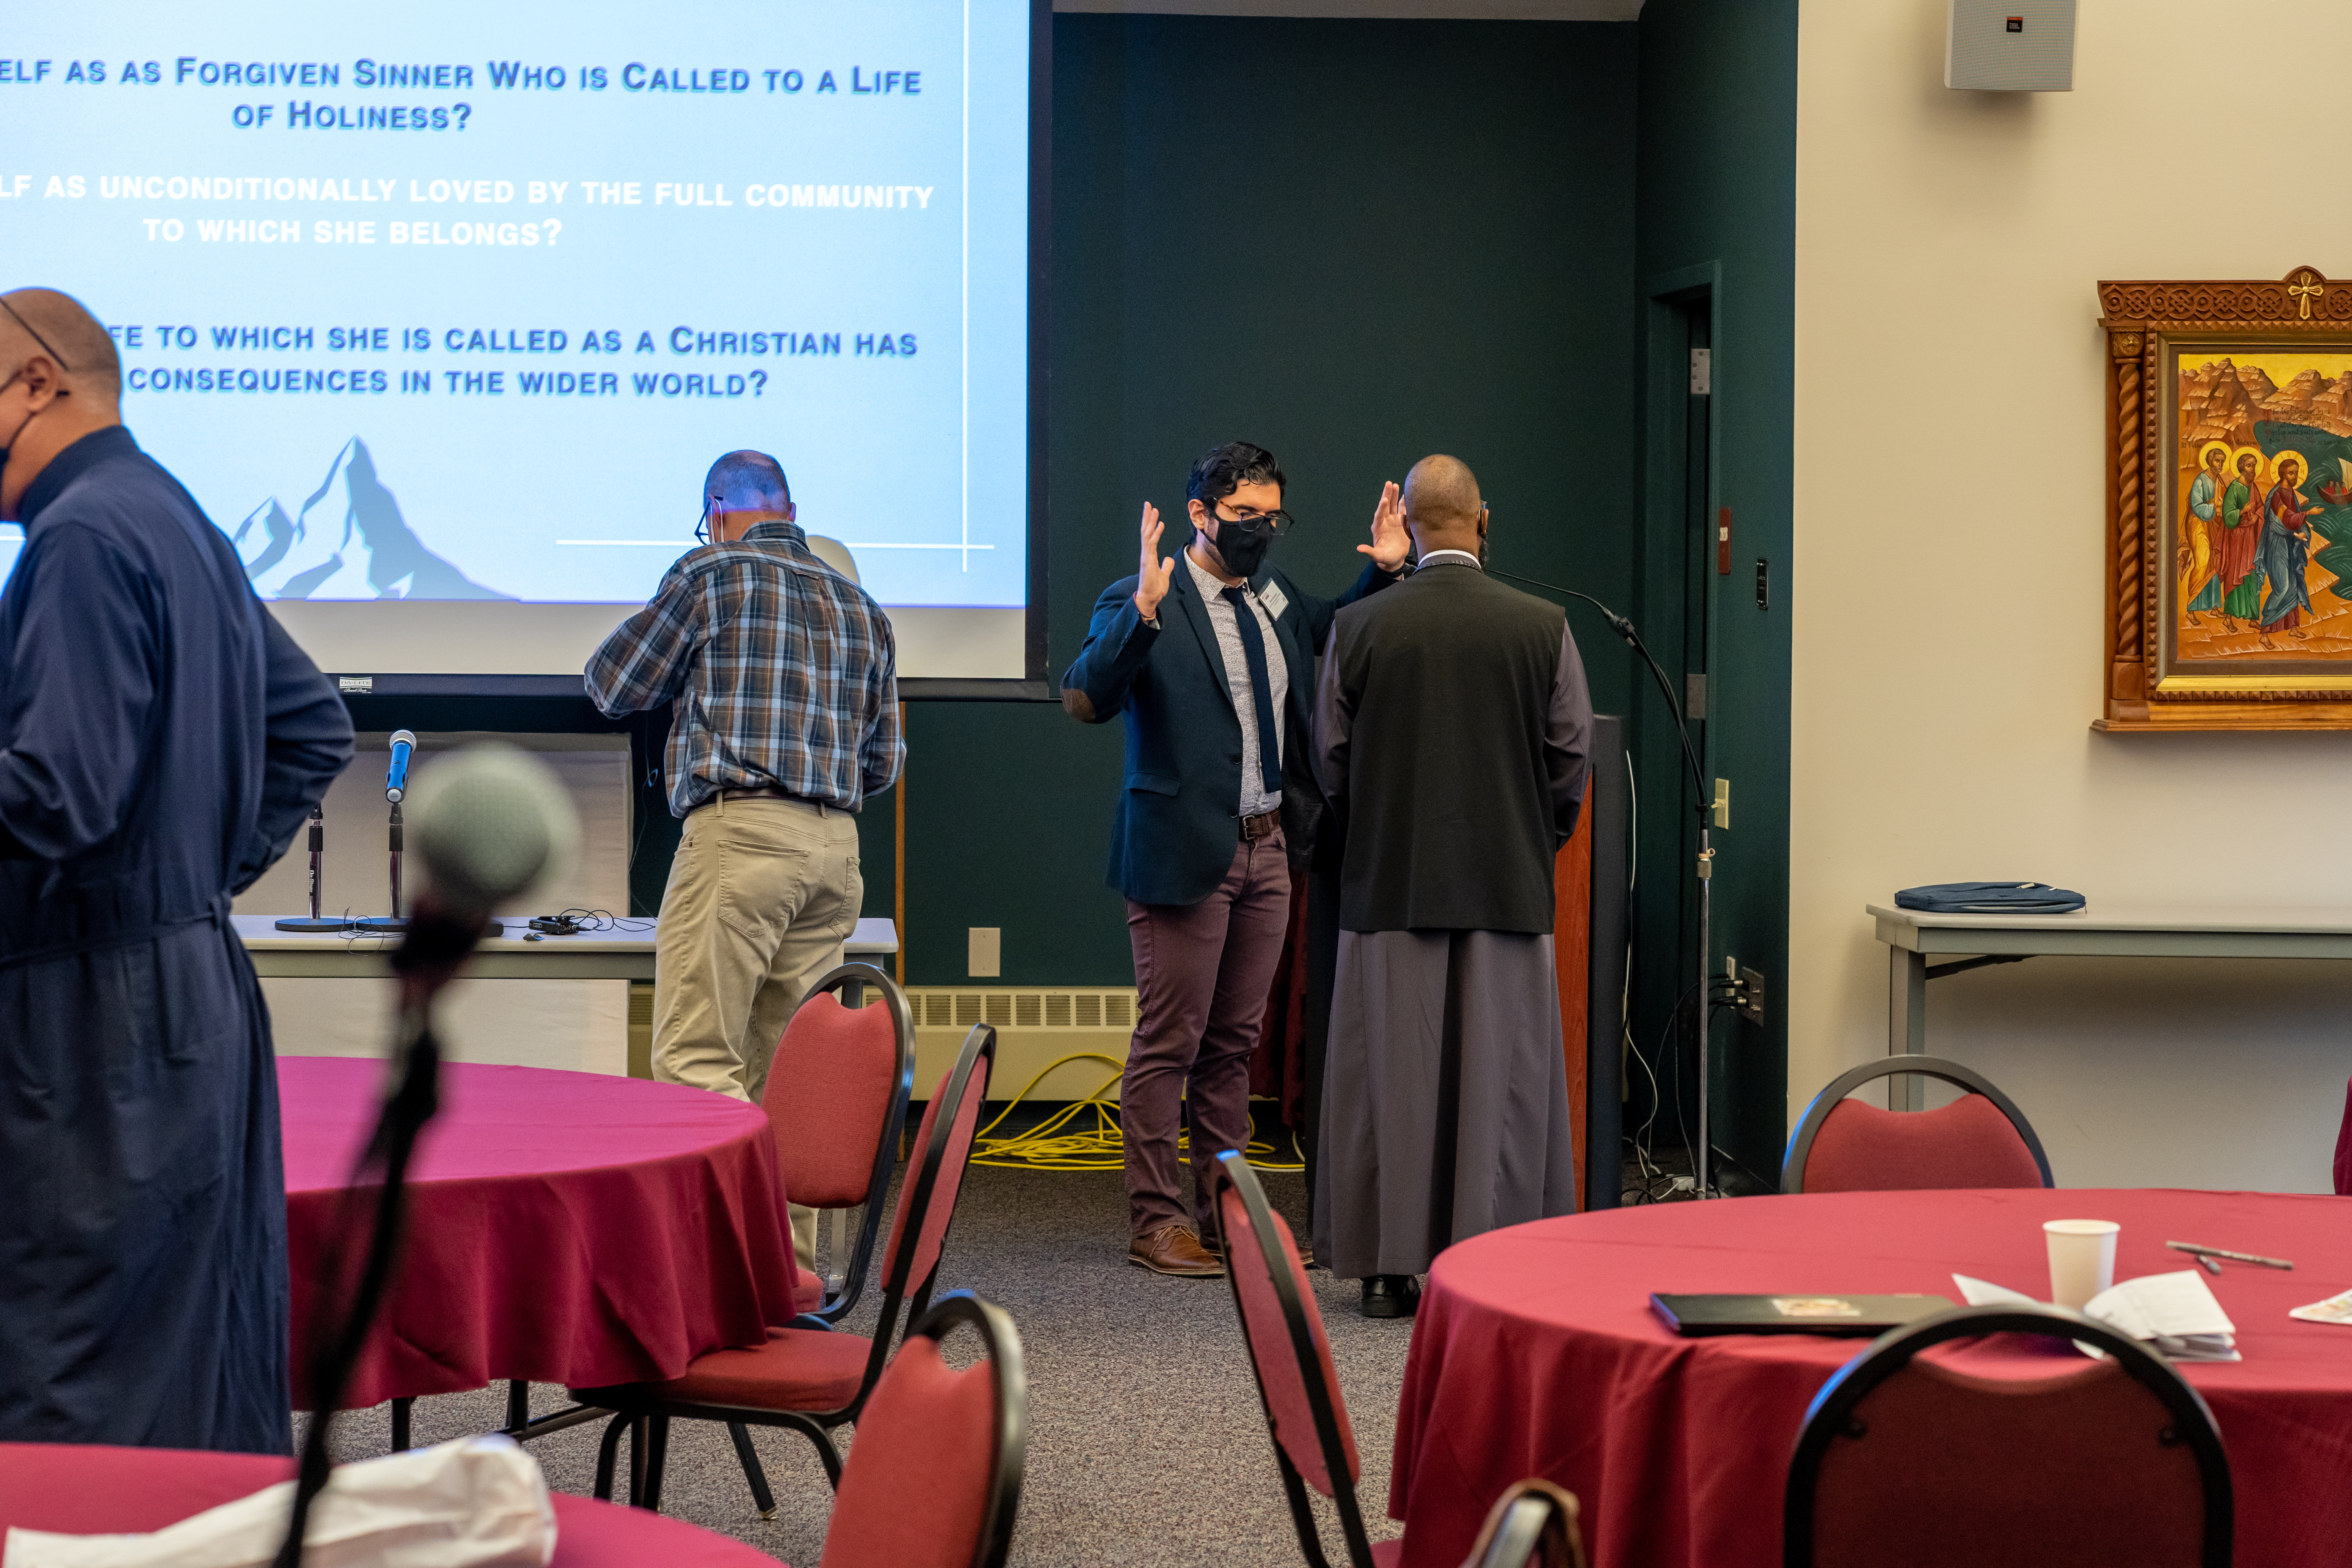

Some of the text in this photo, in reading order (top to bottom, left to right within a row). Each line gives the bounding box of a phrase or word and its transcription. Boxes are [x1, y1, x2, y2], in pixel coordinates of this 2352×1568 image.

[0, 56, 920, 96] ELF AS AS FORGIVEN SINNER WHO IS CALLED TO A LIFE
[232, 101, 472, 132] OF HOLINESS?
[44, 175, 86, 198] AS
[100, 176, 397, 201] UNCONDITIONALLY
[410, 179, 514, 203] LOVED
[528, 181, 569, 203] BY
[581, 181, 642, 205] THE
[655, 182, 733, 206] FULL
[745, 183, 934, 209] COMMUNITY
[142, 218, 562, 246] TO WHICH SHE BELONGS?
[155, 325, 198, 350] TO
[210, 326, 314, 351] WHICH
[327, 327, 389, 352] SHE
[402, 328, 431, 353] IS
[444, 328, 568, 354] CALLED
[580, 330, 622, 355] AS
[634, 330, 655, 355] A
[668, 326, 840, 357] CHRISTIAN
[854, 333, 917, 358] HAS
[127, 367, 768, 398] CONSEQUENCES IN THE WIDER WORLD?
